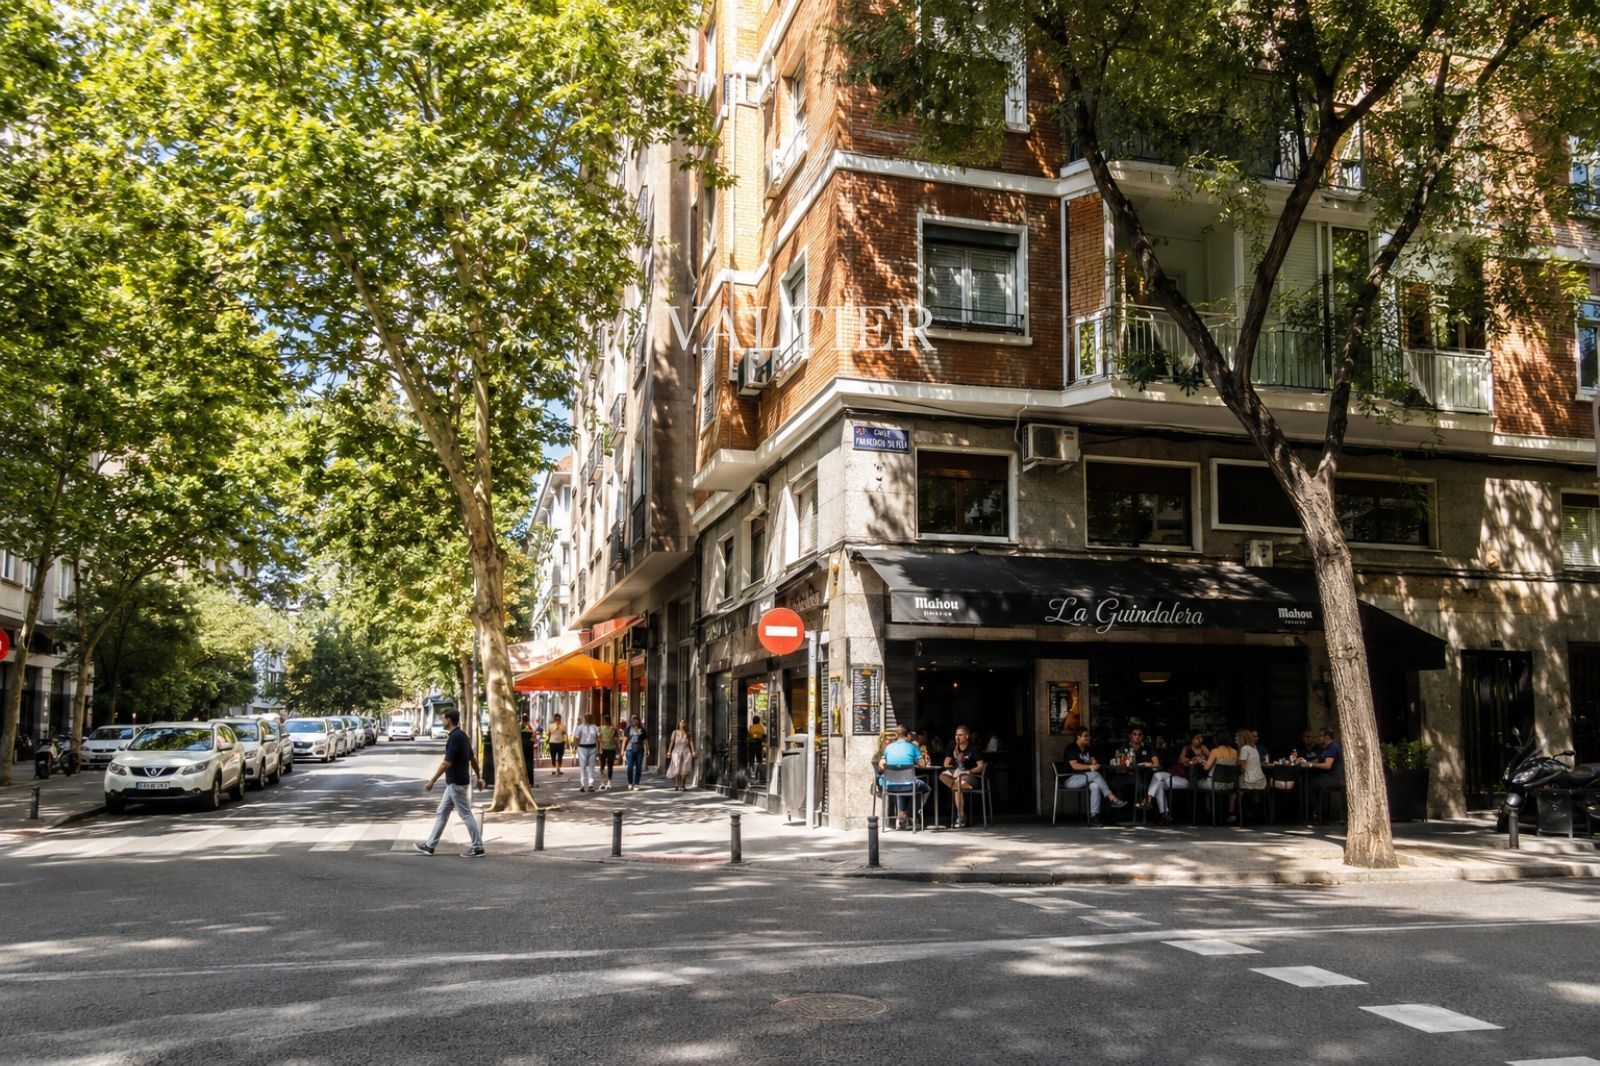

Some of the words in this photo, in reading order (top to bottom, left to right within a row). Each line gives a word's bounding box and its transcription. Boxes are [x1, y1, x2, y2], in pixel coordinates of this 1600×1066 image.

[914, 597, 959, 610] Mahou
[1045, 597, 1088, 626] La
[1096, 597, 1204, 634] Guindalera
[1278, 607, 1313, 619] Mahou
